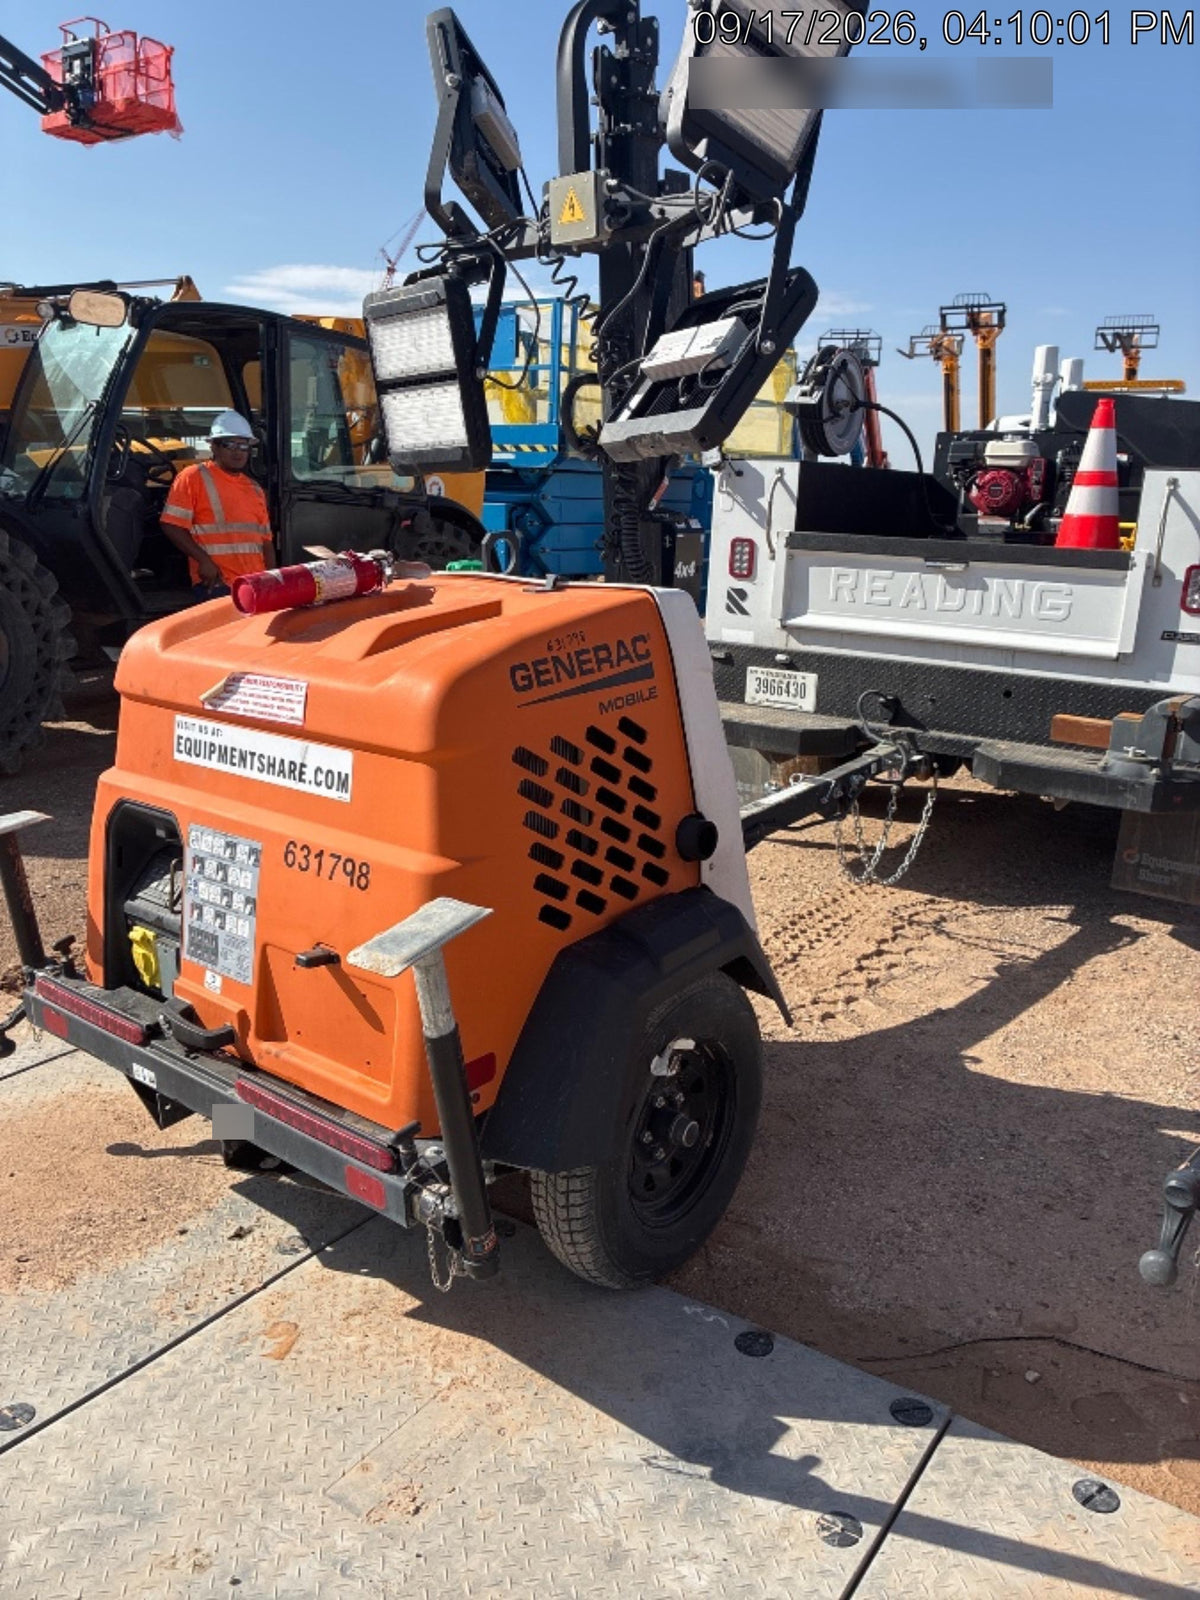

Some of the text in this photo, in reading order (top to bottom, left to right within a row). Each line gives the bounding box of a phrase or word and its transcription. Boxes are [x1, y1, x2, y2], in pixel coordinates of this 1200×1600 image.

[674, 560, 696, 579] 4x4
[829, 567, 1073, 622] READING
[509, 633, 652, 693] GENERAC
[754, 676, 807, 700] 3966430
[598, 686, 659, 715] MOBILE
[176, 734, 350, 795] EQUIPMENTSHARE.COM
[284, 840, 371, 891] 631798
